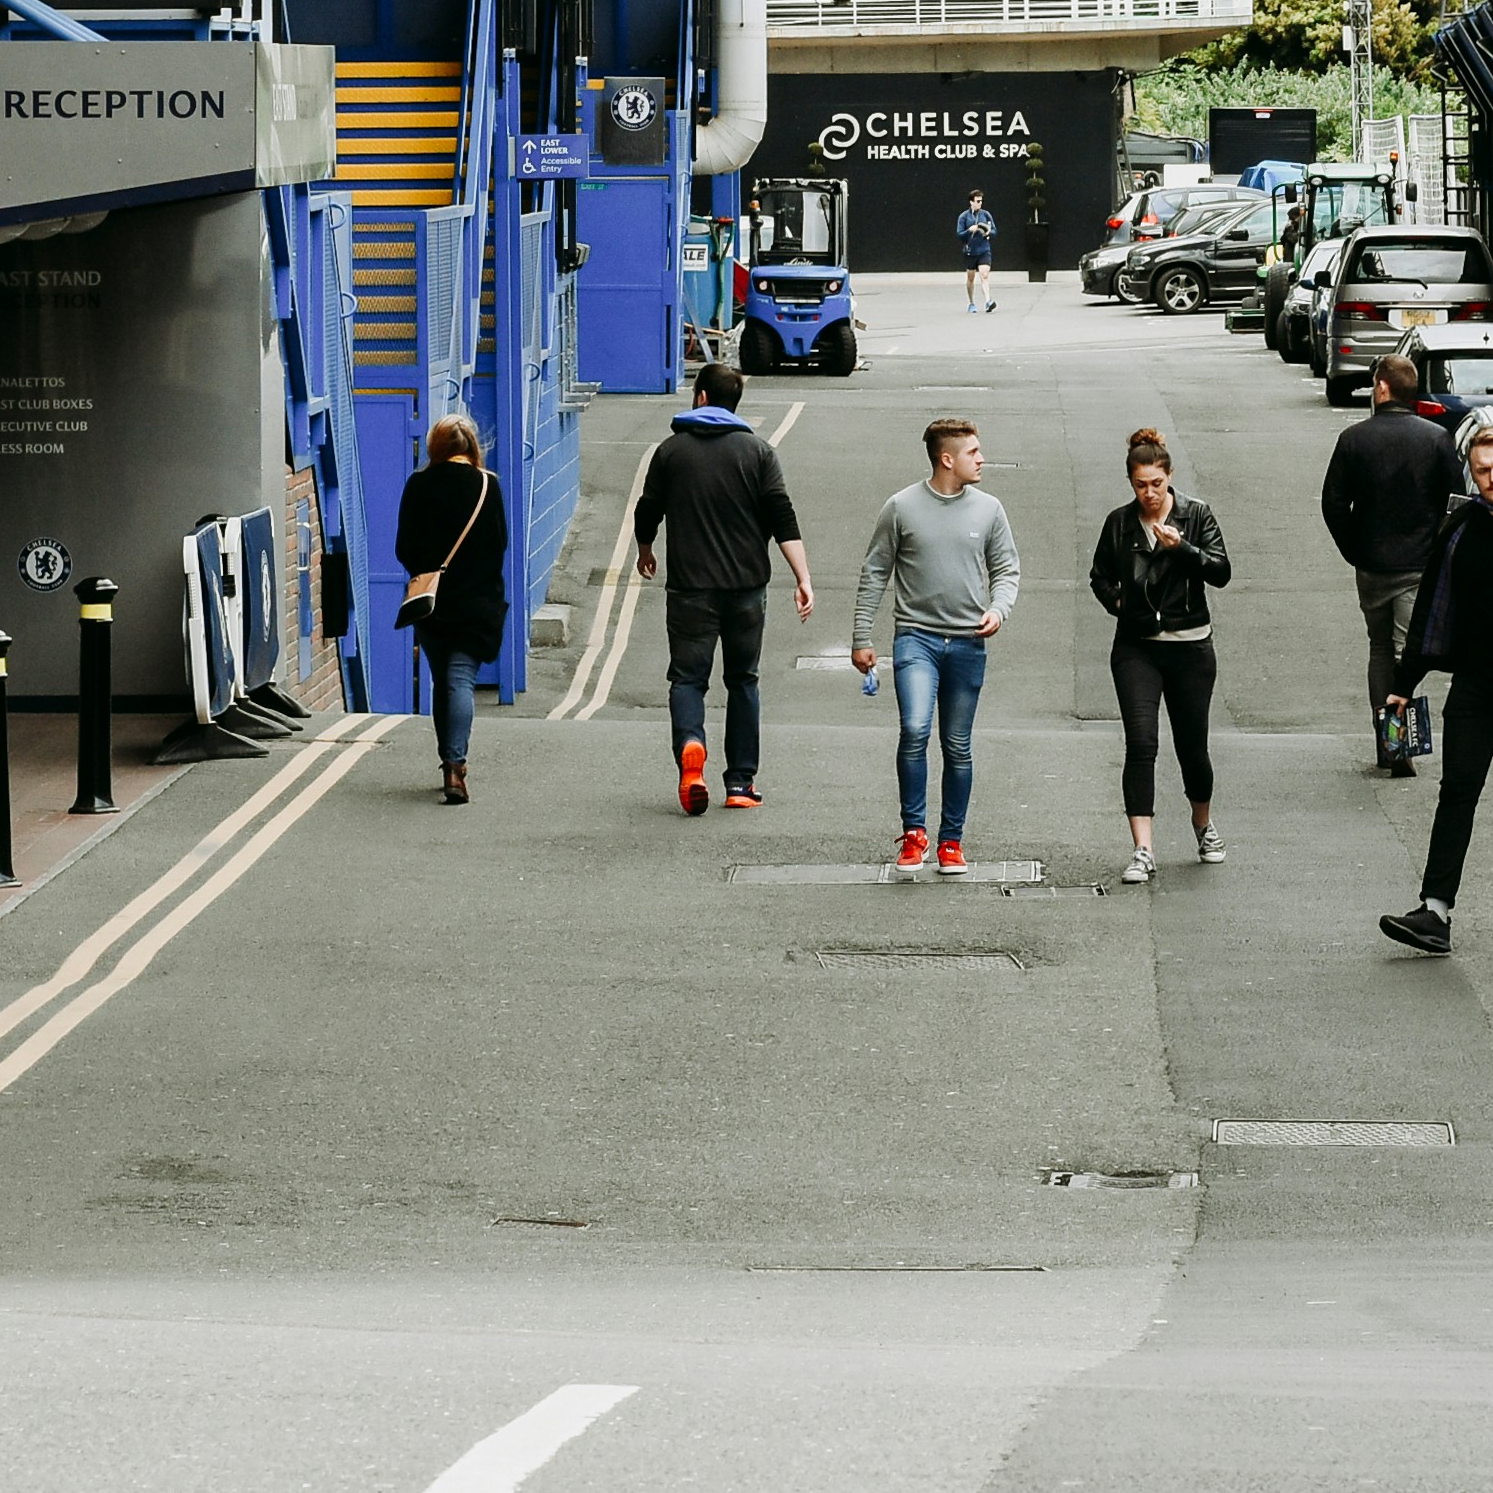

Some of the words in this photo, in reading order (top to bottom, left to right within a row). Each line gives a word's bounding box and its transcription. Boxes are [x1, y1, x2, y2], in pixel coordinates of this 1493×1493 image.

[619, 86, 649, 97] CHELSEA
[5, 90, 226, 118] RECEPTION
[866, 111, 1030, 137] CHELSEA
[541, 139, 561, 147] EAST
[541, 147, 569, 155] LOWER
[867, 145, 929, 159] HEALTH
[934, 144, 977, 158] CLUB
[983, 144, 995, 157] &
[999, 144, 1030, 157] SPA
[541, 157, 582, 165] Accessible
[541, 166, 562, 174] Entry
[38, 270, 102, 287] STAND
[18, 399, 49, 410] CLUB
[52, 399, 94, 410] BOXES
[55, 421, 88, 432] CLUB
[25, 443, 65, 454] ROOM
[27, 539, 63, 551] CHELSEA
